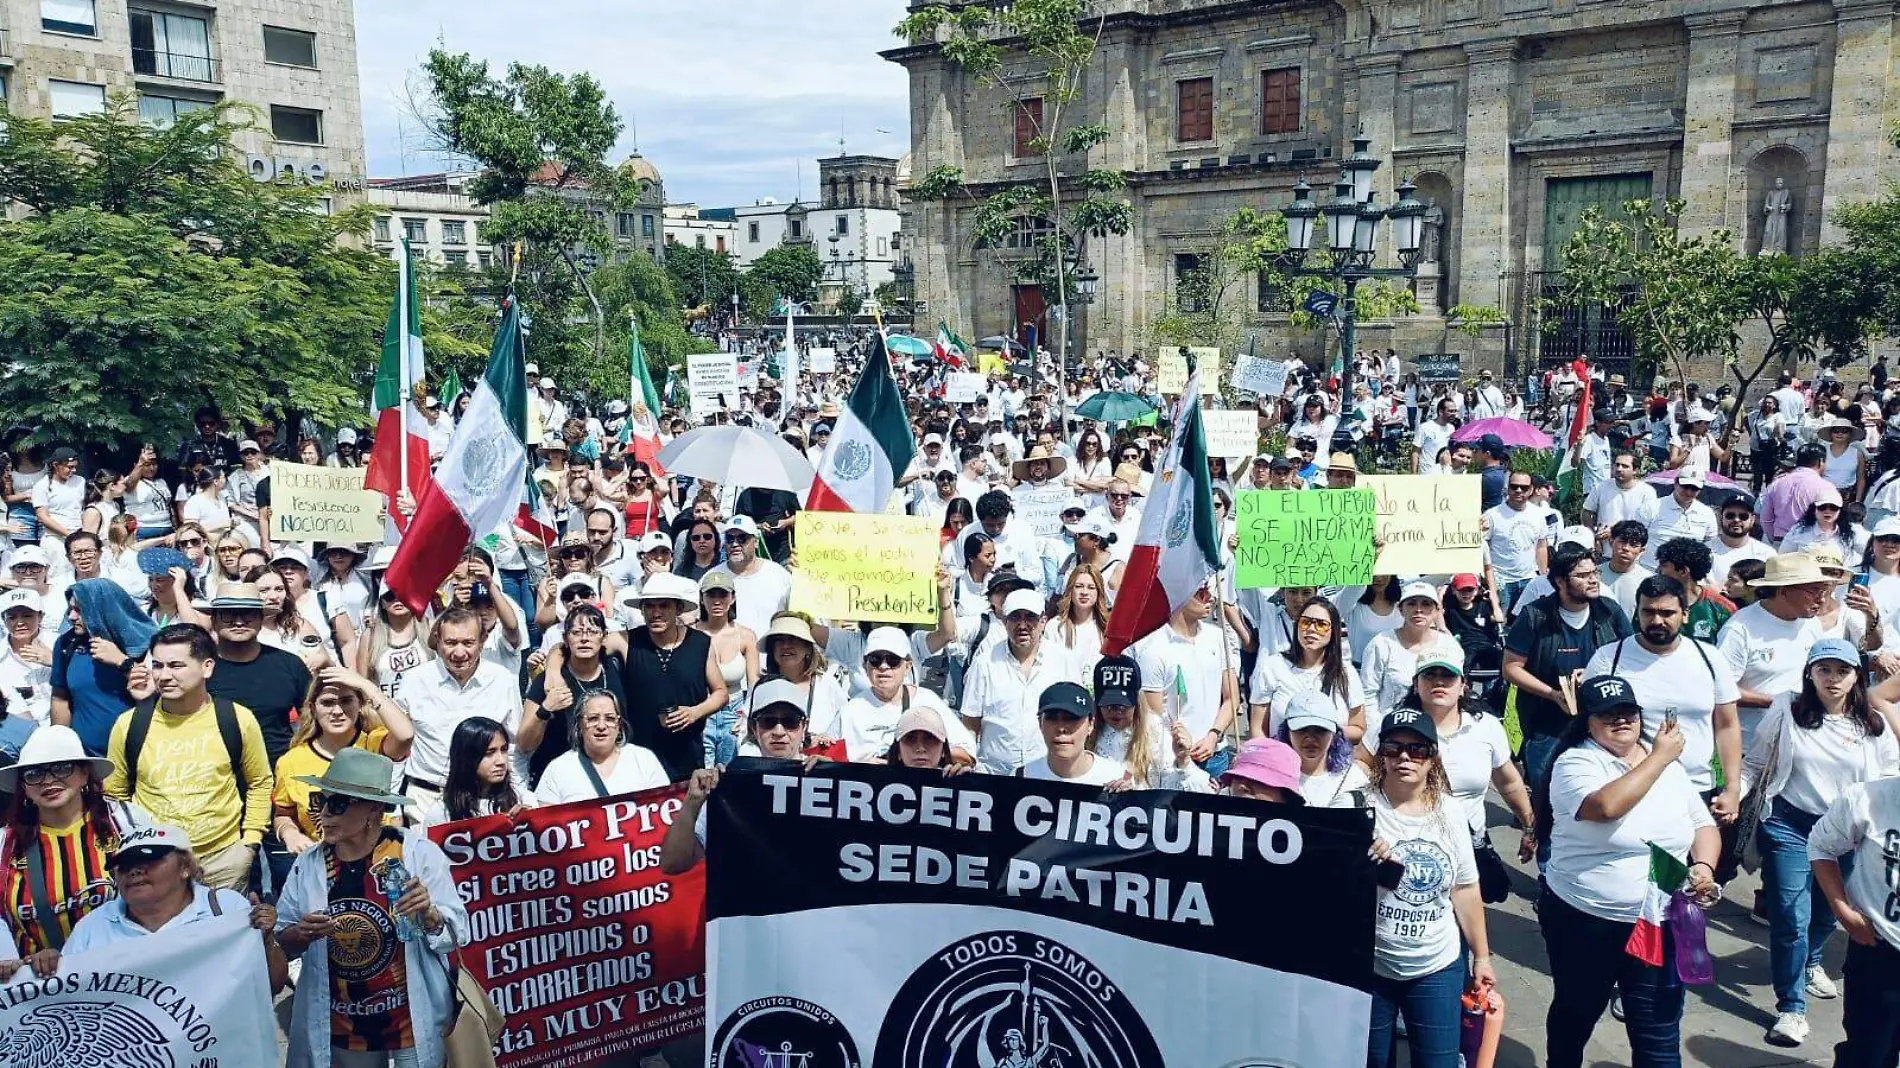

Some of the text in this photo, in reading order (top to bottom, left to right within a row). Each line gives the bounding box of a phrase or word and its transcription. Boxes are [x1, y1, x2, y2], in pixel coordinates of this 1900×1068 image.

[276, 467, 362, 491] PODER JUDICI
[292, 495, 361, 514] resistencia
[1241, 493, 1260, 514] SI
[1281, 491, 1306, 514] EL
[1406, 499, 1420, 514] a
[1433, 483, 1452, 513] la
[280, 514, 354, 533] Nacional
[804, 513, 824, 536] Se
[1250, 516, 1374, 545] SE INFORMA
[1382, 521, 1426, 544] forma
[805, 544, 848, 563] Somos
[1239, 542, 1374, 568] NO PASA LA
[1272, 561, 1373, 586] REFORMA
[1102, 671, 1133, 687] PJF
[1600, 684, 1624, 699] PJF
[1393, 711, 1418, 725] PJF
[443, 797, 684, 867] Señor Pre
[762, 774, 1303, 865] TERCER CIRCUITO
[458, 843, 661, 905] si cree que los
[838, 843, 1215, 927] SEDE PATRIA
[1408, 861, 1435, 884] NY
[582, 882, 670, 920] somos
[351, 901, 393, 934] NEGROS
[1393, 922, 1427, 937] 1987
[485, 922, 649, 980] ESTUPIDOS o
[939, 935, 1117, 1002] TODOS SOMOS
[489, 951, 652, 1017] ACARREADOS
[85, 972, 218, 1053] MEXICANOS
[543, 994, 627, 1043] MUY
[634, 971, 707, 1014] EQU
[737, 997, 837, 1026] CIRCUITOS UNIDOS
